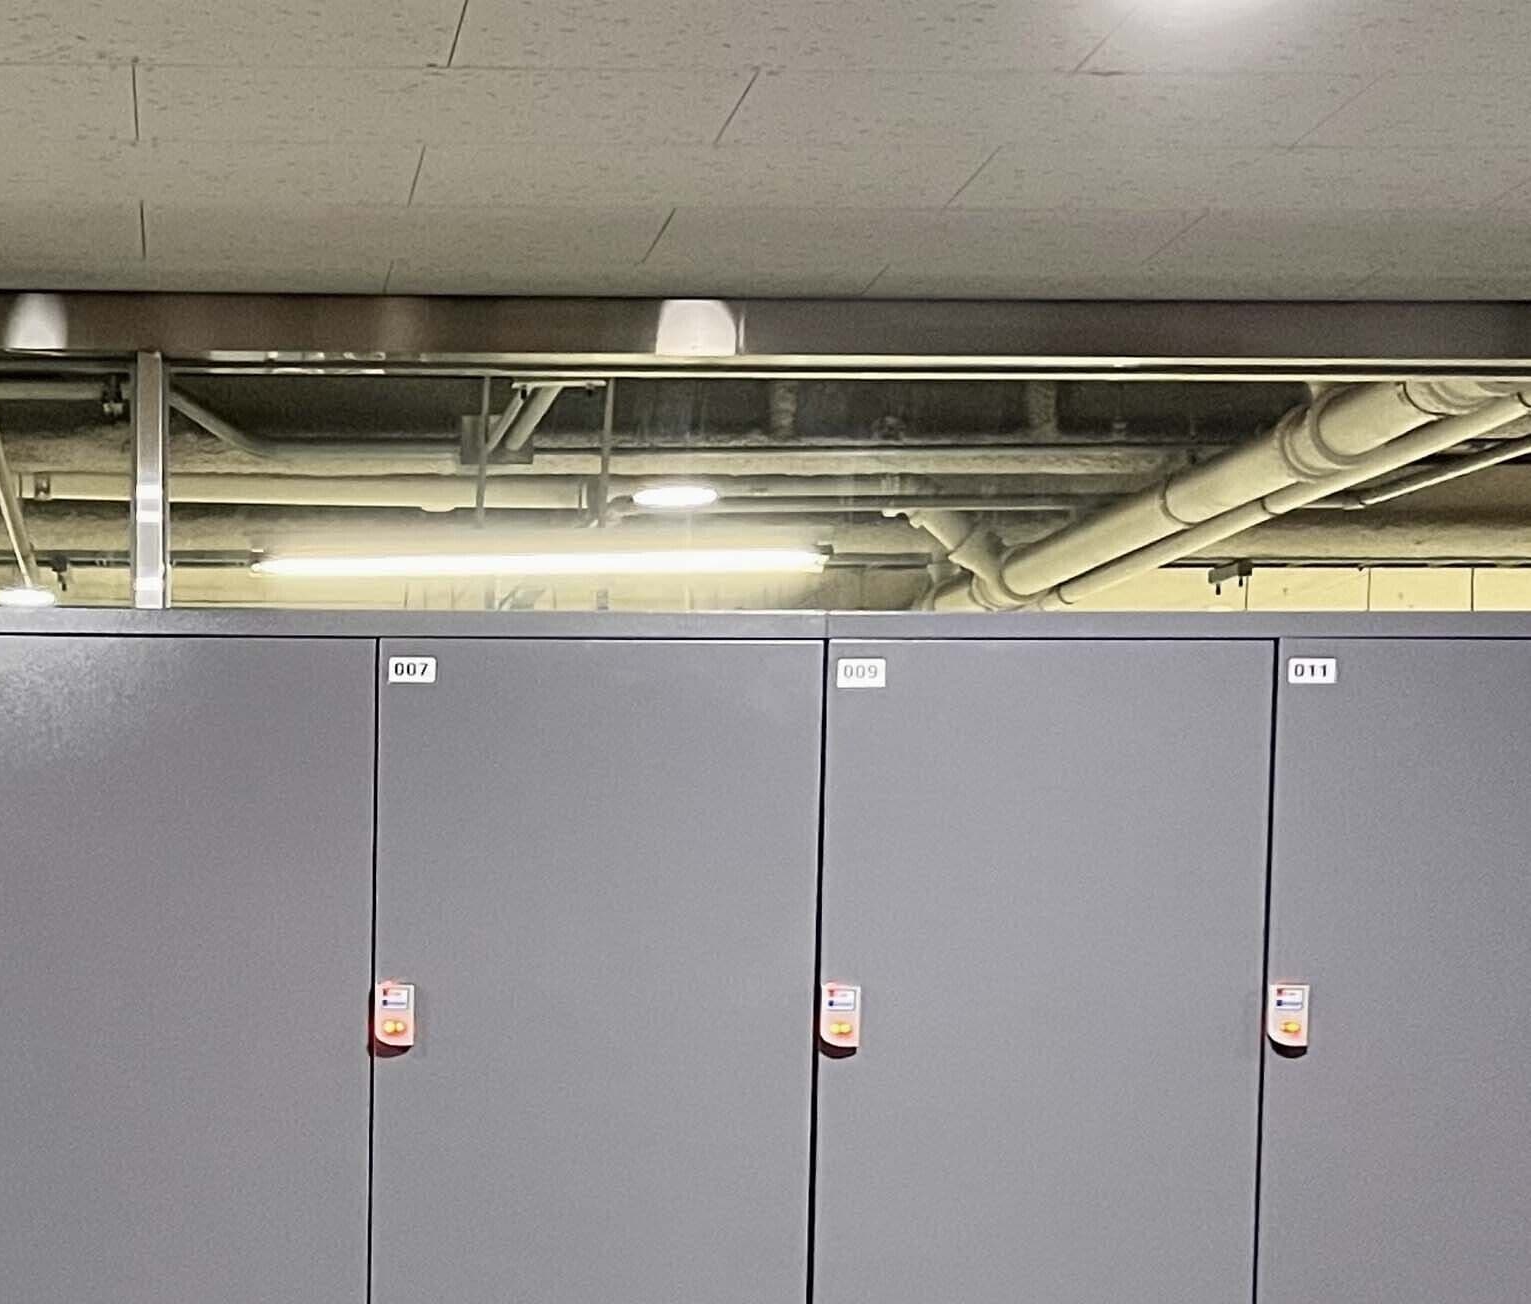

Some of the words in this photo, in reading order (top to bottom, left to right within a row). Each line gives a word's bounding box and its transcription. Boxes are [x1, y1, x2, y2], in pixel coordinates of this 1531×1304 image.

[395, 662, 429, 677] 007
[844, 664, 877, 679] 009
[1294, 664, 1328, 677] 011
